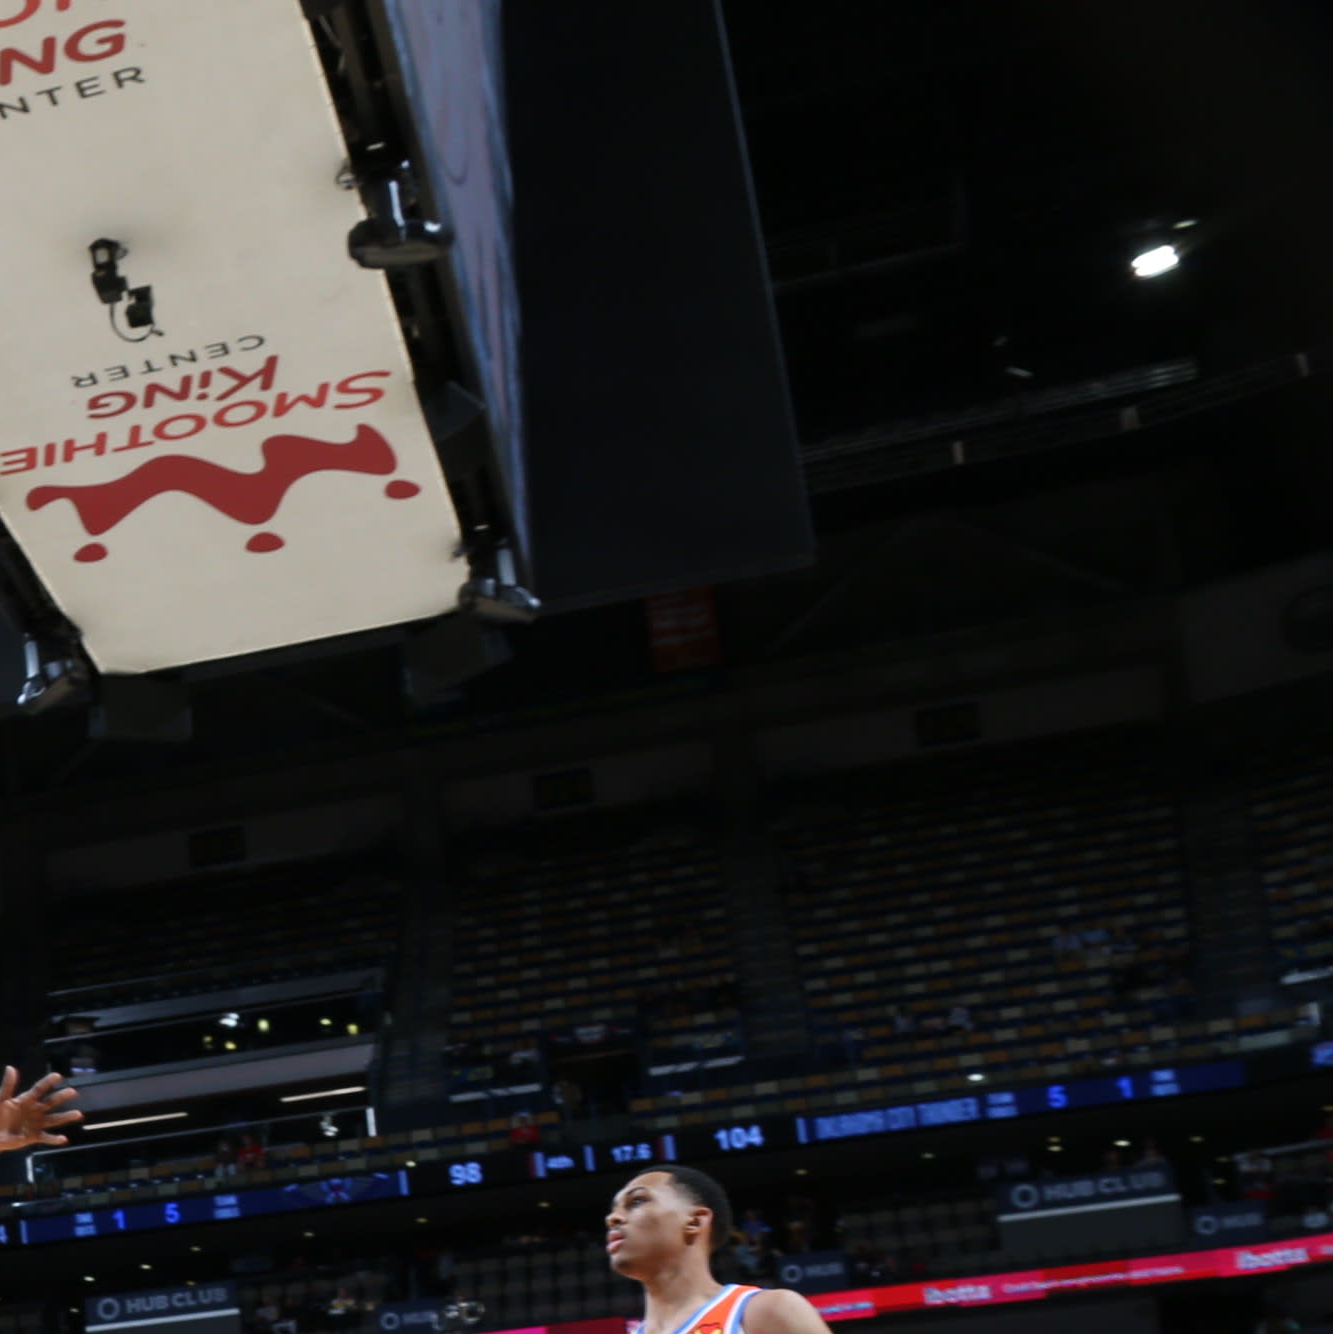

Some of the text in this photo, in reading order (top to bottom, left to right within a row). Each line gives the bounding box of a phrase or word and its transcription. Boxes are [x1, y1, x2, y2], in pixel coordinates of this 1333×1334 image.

[71, 335, 266, 389] CENTER
[1046, 1085, 1068, 1108] 5
[448, 1162, 483, 1185] 98
[714, 1125, 765, 1151] 104
[165, 1203, 182, 1224] 5
[126, 1294, 169, 1314] HUB
